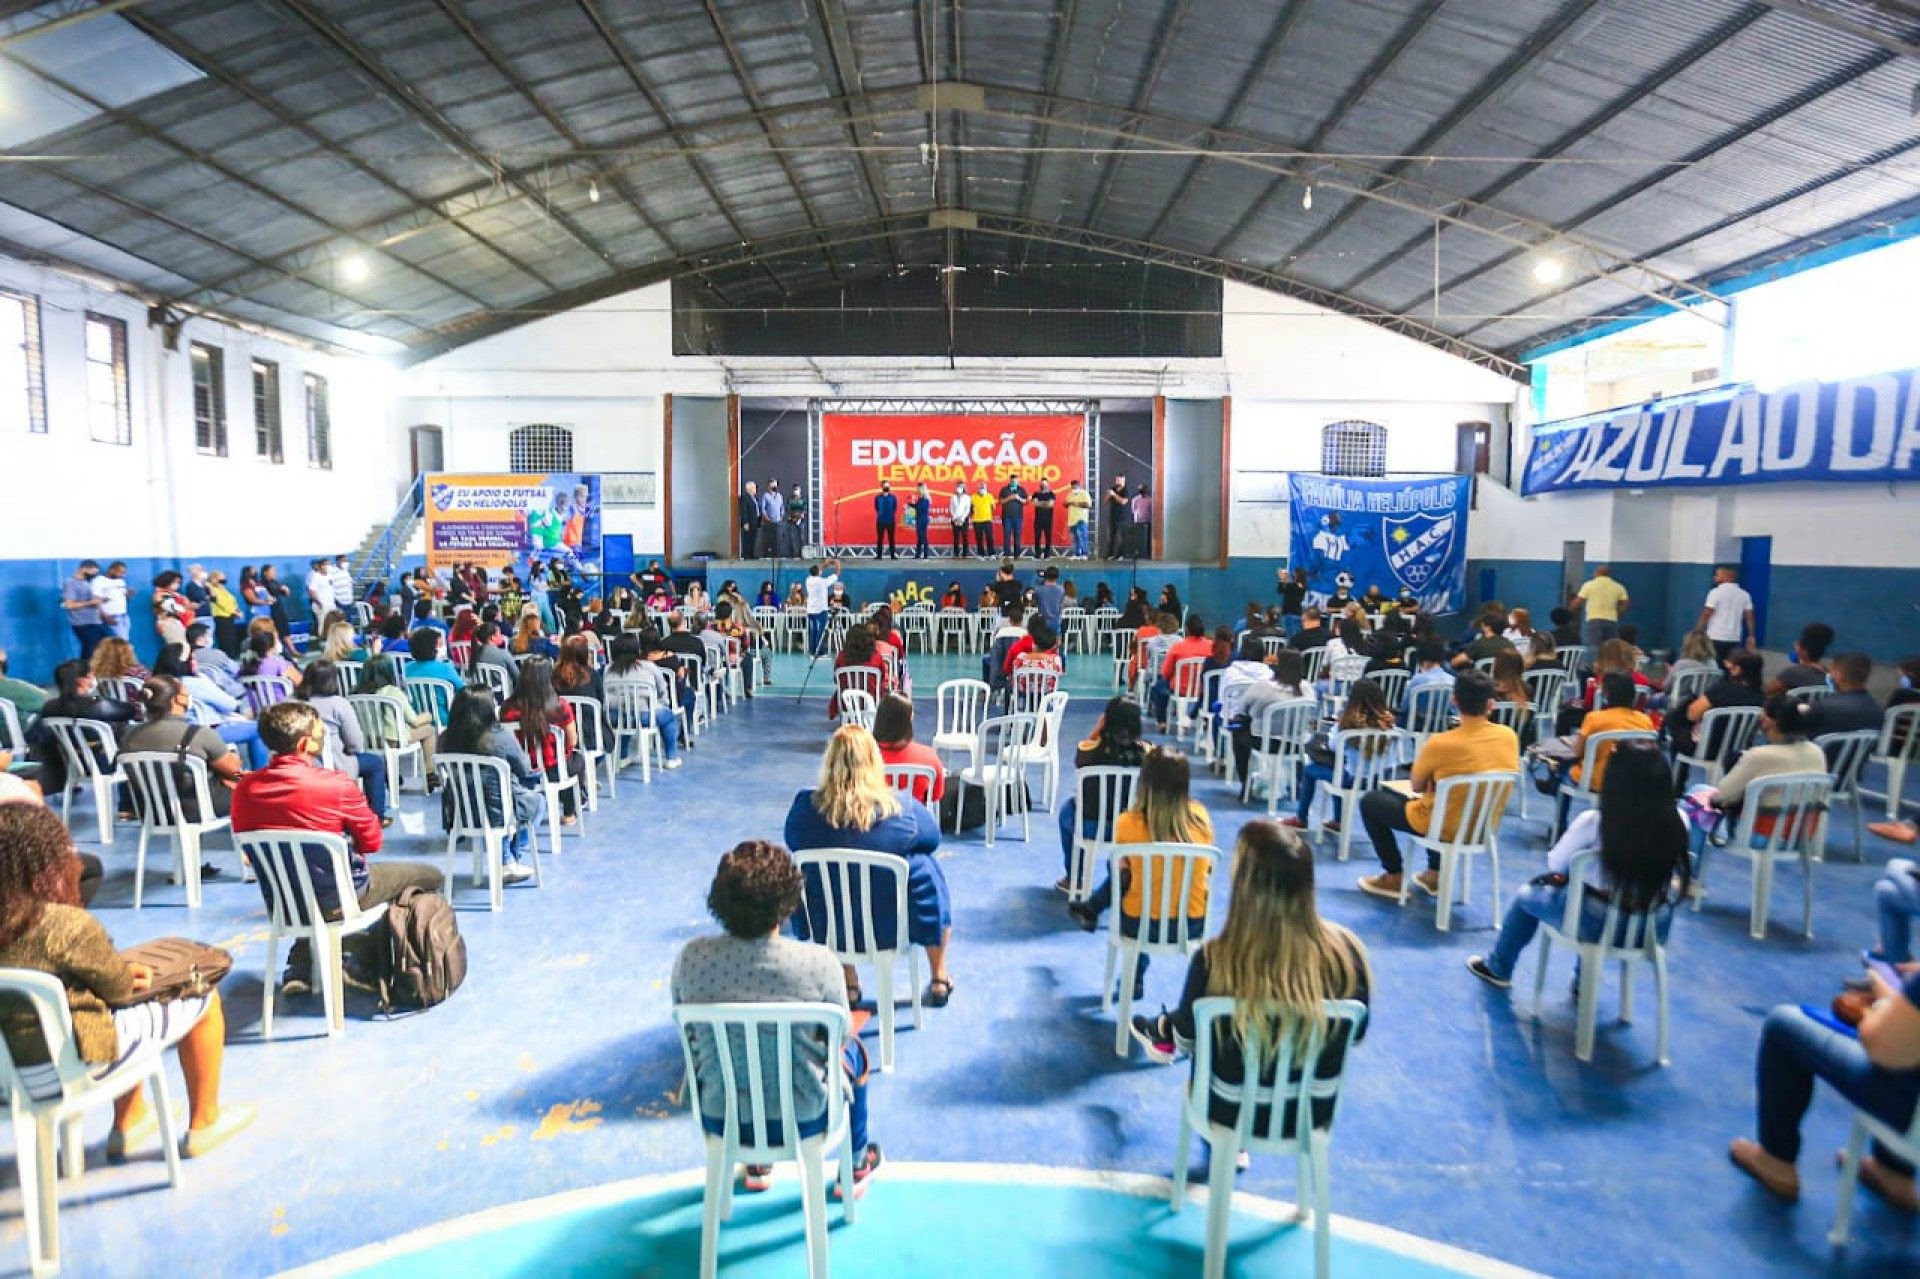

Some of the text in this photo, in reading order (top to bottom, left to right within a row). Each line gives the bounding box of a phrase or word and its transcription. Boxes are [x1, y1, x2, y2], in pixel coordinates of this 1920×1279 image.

[877, 464, 966, 482] LEVADA
[472, 489, 502, 498] APOIO
[512, 489, 547, 498] FUTSAL
